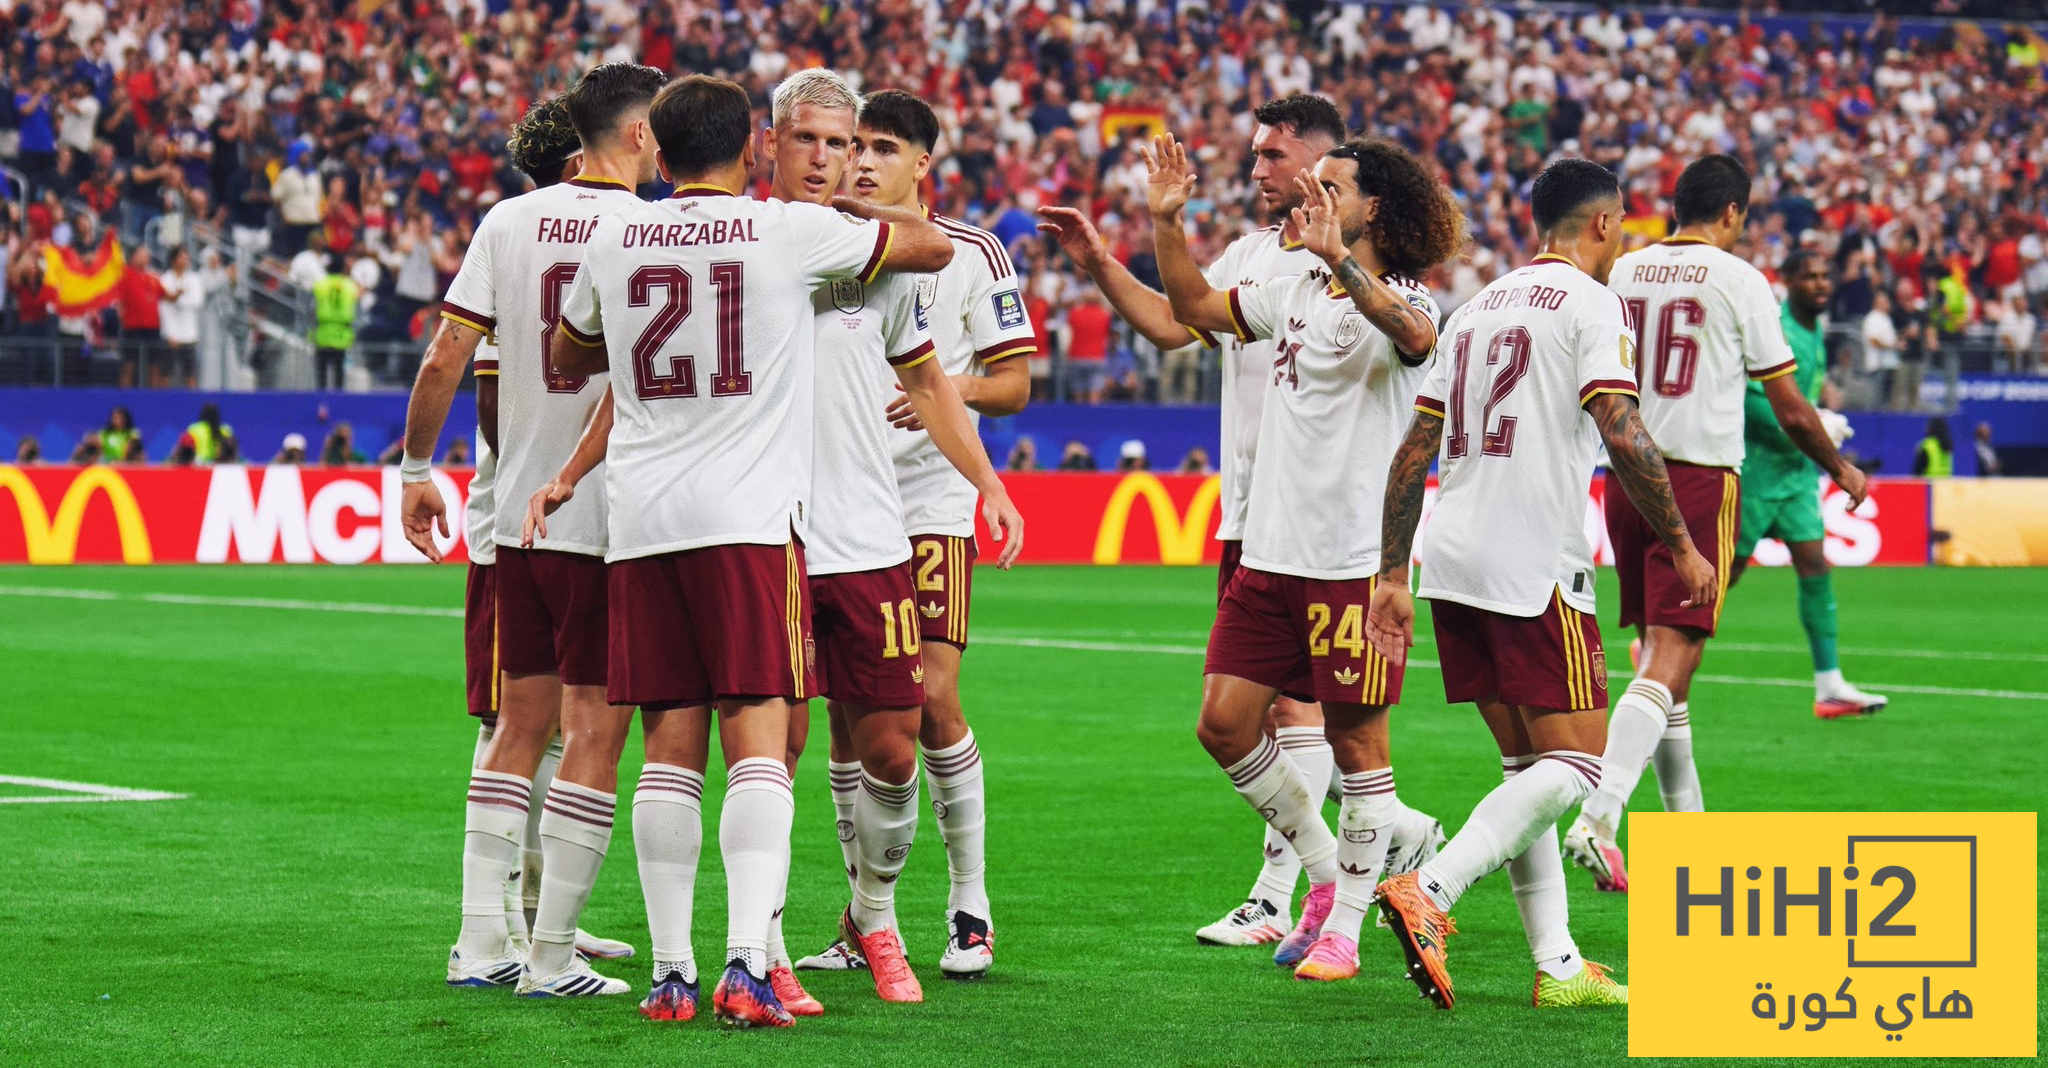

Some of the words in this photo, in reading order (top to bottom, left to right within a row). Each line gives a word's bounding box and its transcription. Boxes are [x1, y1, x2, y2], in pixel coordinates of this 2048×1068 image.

[537, 215, 600, 244] FABIÁ
[622, 219, 759, 249] OYARZABAL
[1505, 285, 1568, 311] PORRO
[1633, 265, 1709, 284] RODRIGO
[628, 261, 753, 401] 21
[1627, 297, 1707, 400] 16
[1447, 326, 1533, 460] 12
[195, 464, 465, 565] McD
[880, 597, 919, 658] 10
[1307, 602, 1365, 658] 24
